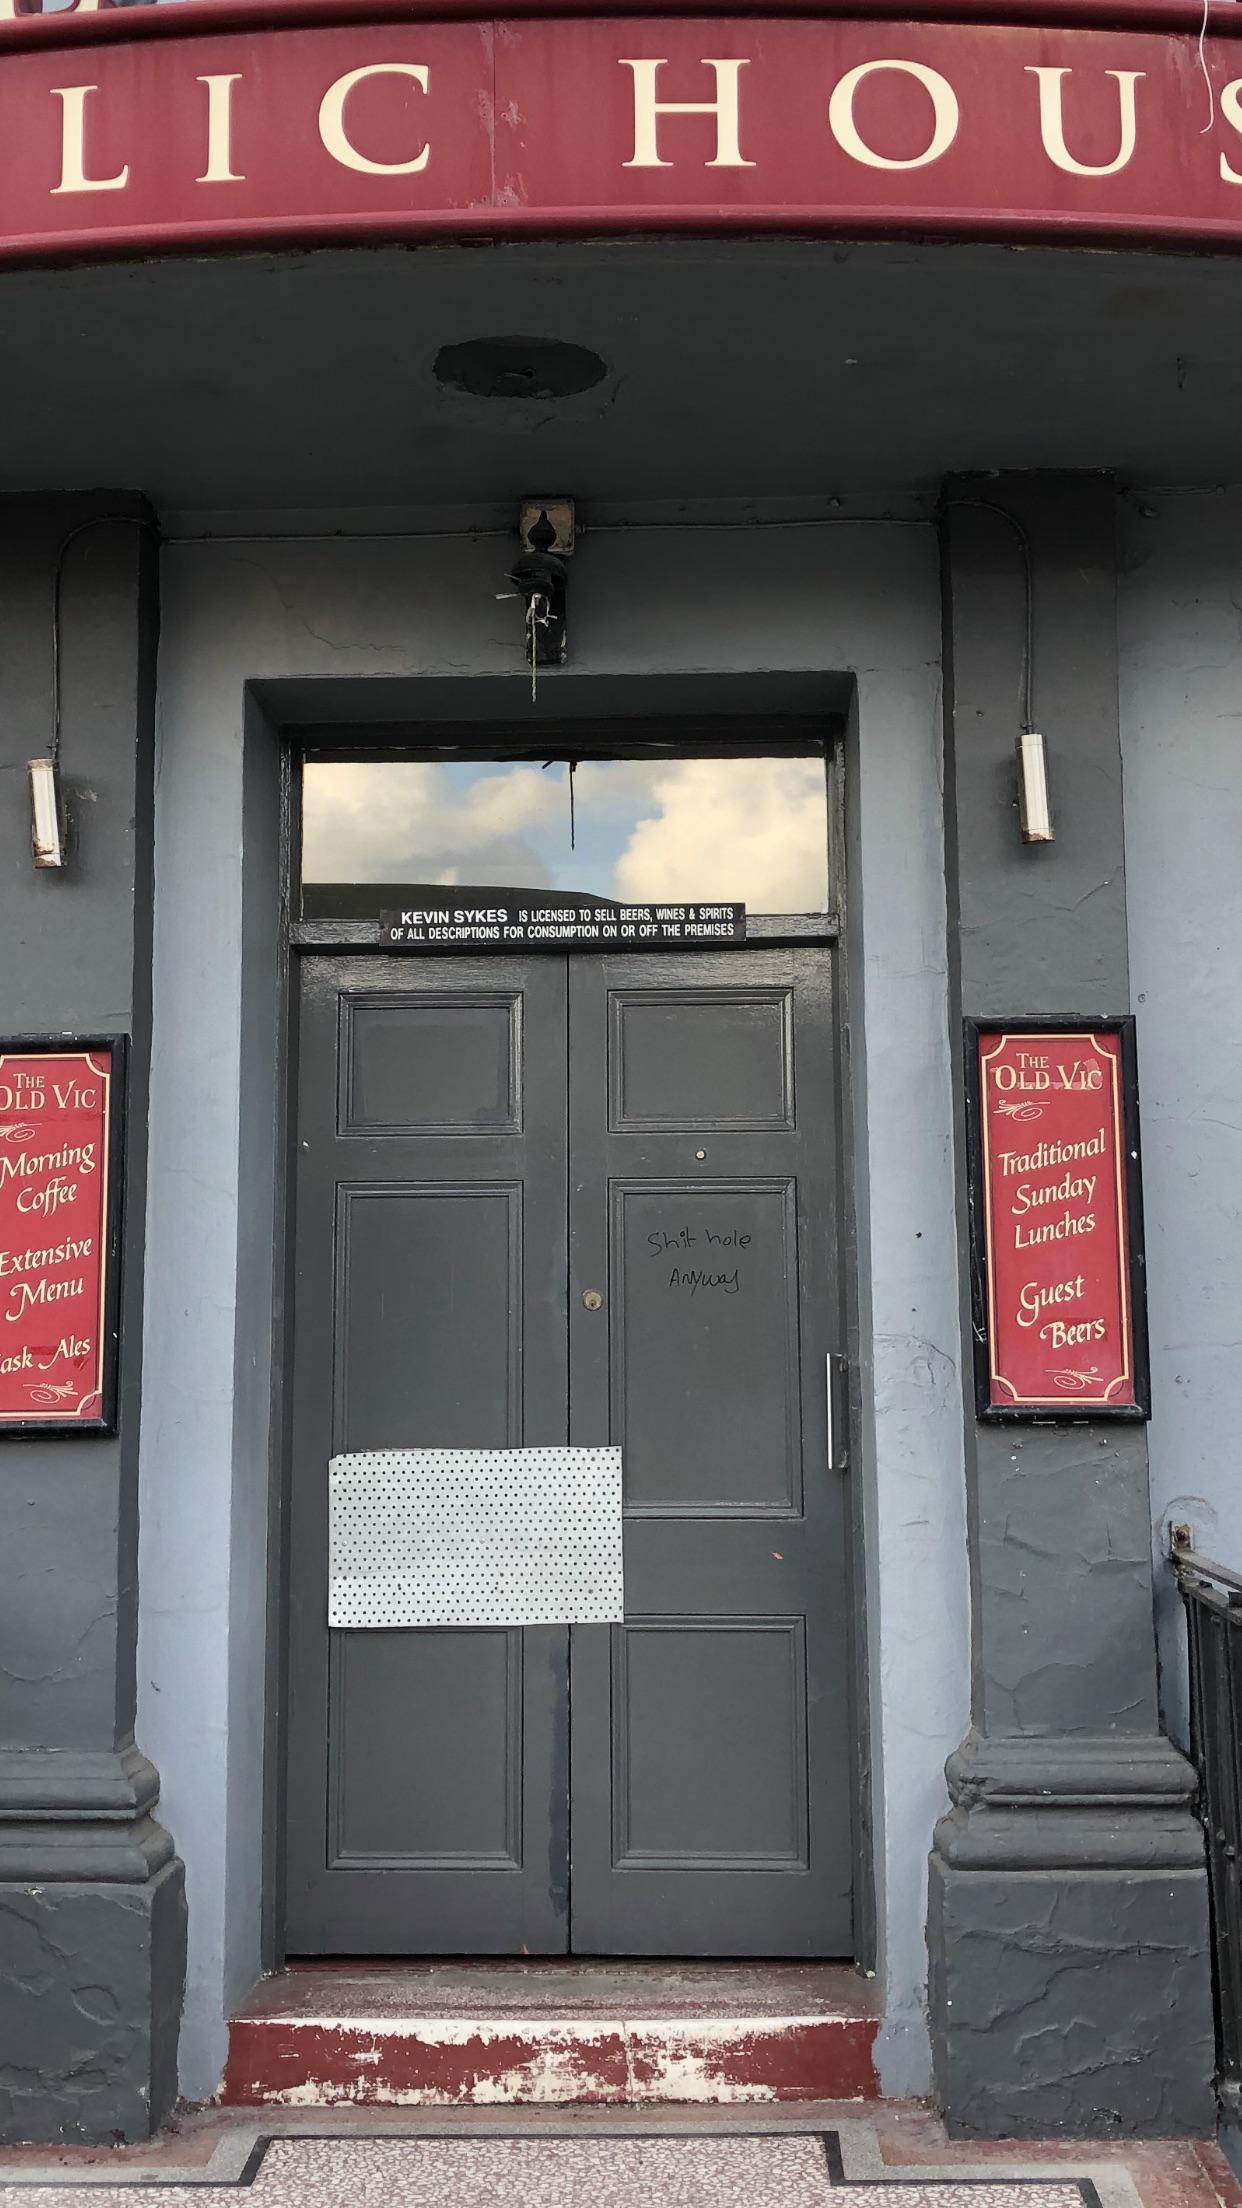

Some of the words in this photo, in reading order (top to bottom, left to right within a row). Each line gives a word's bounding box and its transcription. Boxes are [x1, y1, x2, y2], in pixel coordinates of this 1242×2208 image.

[49, 62, 431, 195] LIC
[390, 927, 404, 940] OF
[407, 927, 425, 940] ALL
[428, 926, 500, 939] DESCRIPTIONS
[503, 926, 524, 939] FOR
[527, 925, 599, 938] CONSUMPTION
[602, 925, 618, 937] ON
[621, 924, 635, 937] OR
[639, 924, 658, 937] OFF
[662, 924, 681, 936] THE
[684, 923, 735, 936] PREMISES
[401, 911, 449, 925] KEVIN
[454, 909, 508, 924] SYKES
[518, 910, 528, 922] IS
[531, 909, 576, 922] LICENSED
[579, 909, 591, 921] TO
[594, 909, 617, 921] SELL
[620, 908, 653, 923] BEERS,
[656, 907, 686, 920] WINES
[689, 907, 696, 920] &
[699, 907, 734, 920] SPIRITS
[0, 1142, 96, 1188] Morning
[997, 1128, 1107, 1177] Traditional
[16, 1175, 78, 1218] Coffee
[1011, 1172, 1097, 1215] Sunday
[647, 1226, 697, 1257] Shit
[704, 1228, 752, 1249] hole
[1014, 1210, 1096, 1249] Lunches
[0, 1236, 93, 1277] Extensive
[5, 1277, 84, 1321] Menu
[668, 1267, 740, 1297] Anyway
[1016, 1274, 1085, 1327] Guest
[1039, 1318, 1106, 1349] Beers
[0, 1346, 33, 1375] ask
[38, 1335, 91, 1370] Ales
